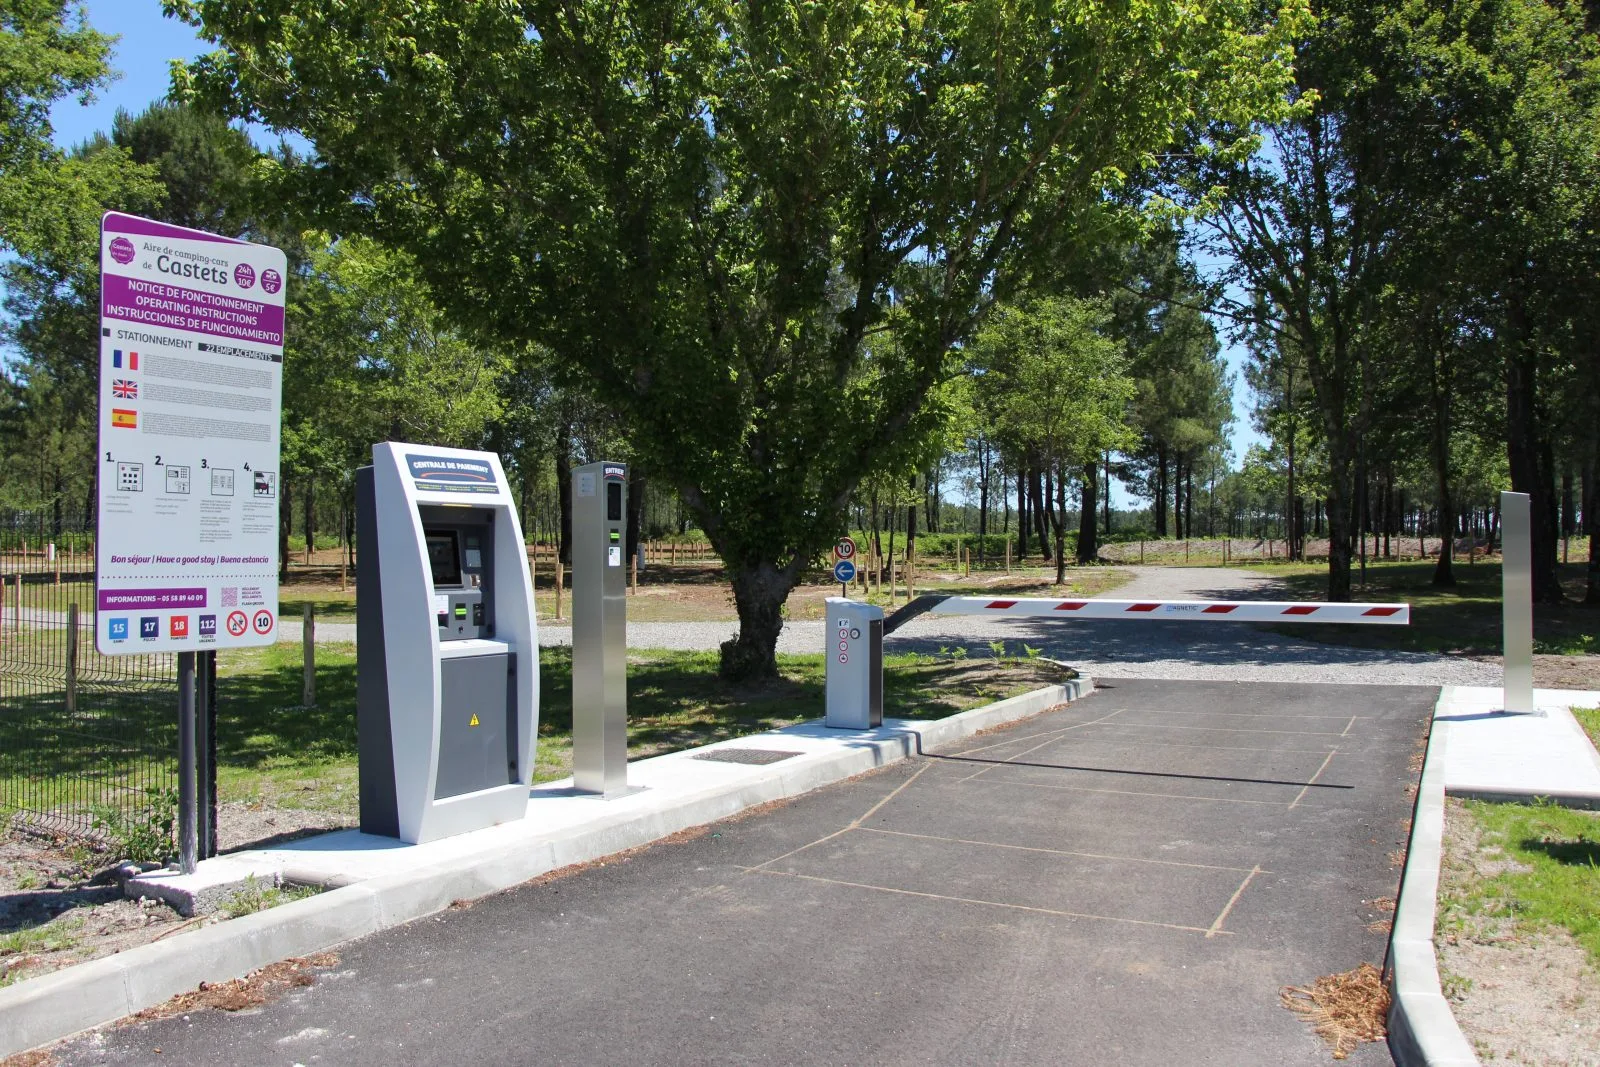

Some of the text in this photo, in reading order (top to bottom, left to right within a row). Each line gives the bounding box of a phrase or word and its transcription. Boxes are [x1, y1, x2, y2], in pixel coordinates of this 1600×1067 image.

[143, 242, 229, 268] Aire de camping-cars
[142, 254, 228, 285] de Castets
[238, 265, 252, 276] 24h
[238, 277, 252, 288] 10€
[265, 283, 276, 292] 5€
[128, 279, 265, 314] NOTICE DE FONCTIONNEMENT
[135, 295, 258, 326] OPERATING INSTRUCTIONS
[106, 304, 280, 342] INSTRUCCIONES DE FUNCIONAMIENTO
[117, 329, 193, 350] STATIONNEMENT
[205, 343, 273, 362] 22 EMPLACEMENTS
[105, 452, 115, 463] 1.
[155, 455, 164, 466] 2.
[201, 458, 210, 469] 3.
[243, 462, 252, 472] 4.
[413, 461, 446, 469] CENTRALE
[456, 462, 489, 473] PAIEMENT
[839, 544, 851, 554] 10
[111, 555, 126, 564] Bon
[127, 553, 151, 566] séjour
[156, 555, 175, 564] Have
[181, 555, 200, 566] good
[200, 556, 216, 566] stay
[220, 556, 241, 564] Buena
[241, 556, 269, 564] estancia
[106, 595, 157, 603] INFORMATIONS
[144, 622, 156, 632] 17
[174, 620, 185, 631] 18
[200, 620, 216, 630] 112
[257, 617, 269, 627] 10
[113, 623, 125, 633] 15
